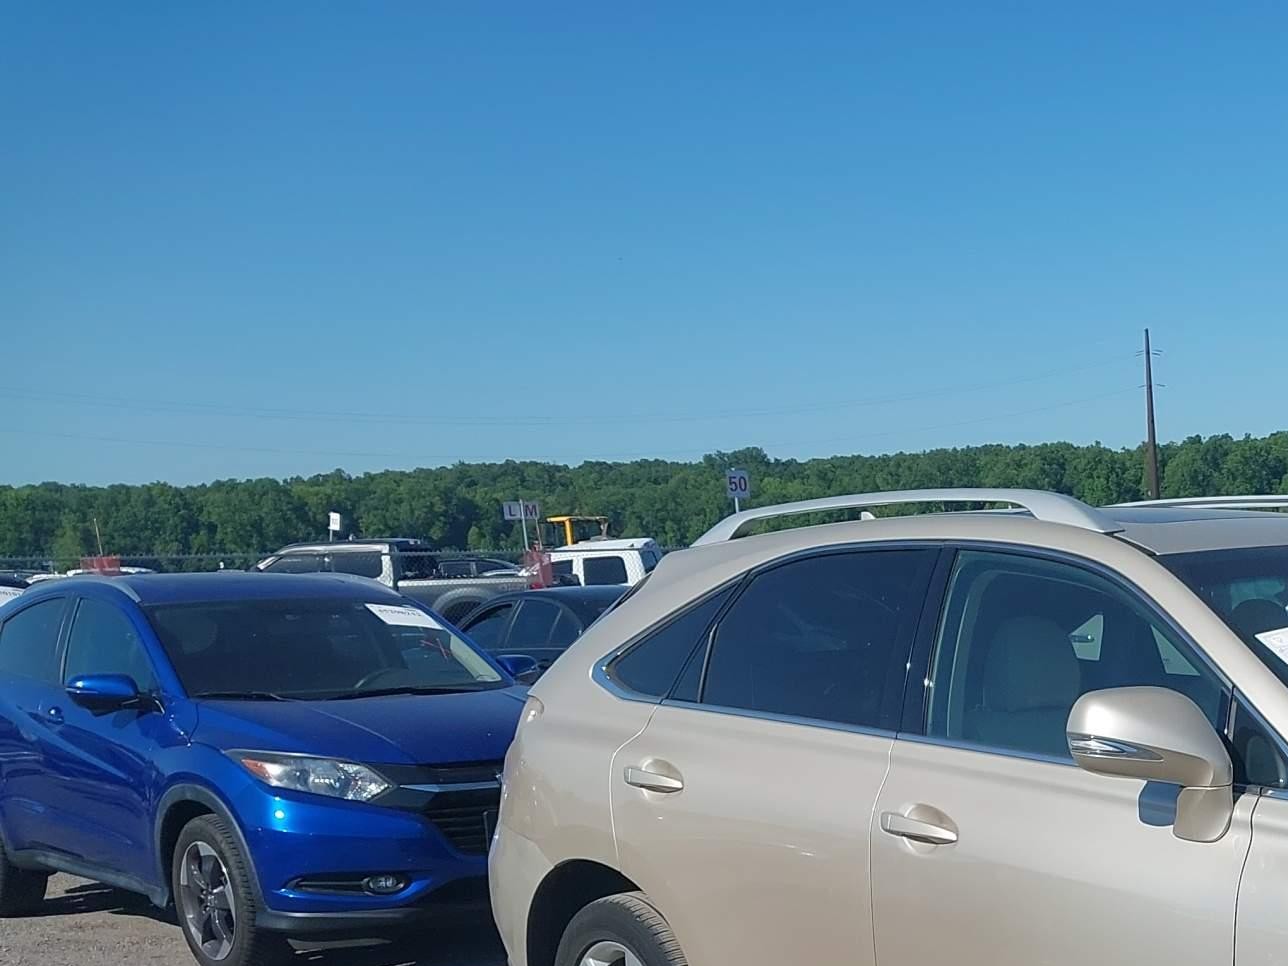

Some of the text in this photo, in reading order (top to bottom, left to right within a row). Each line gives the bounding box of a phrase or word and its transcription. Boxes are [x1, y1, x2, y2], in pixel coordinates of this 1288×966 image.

[729, 476, 747, 492] 50
[508, 505, 517, 517] L
[525, 505, 537, 516] M
